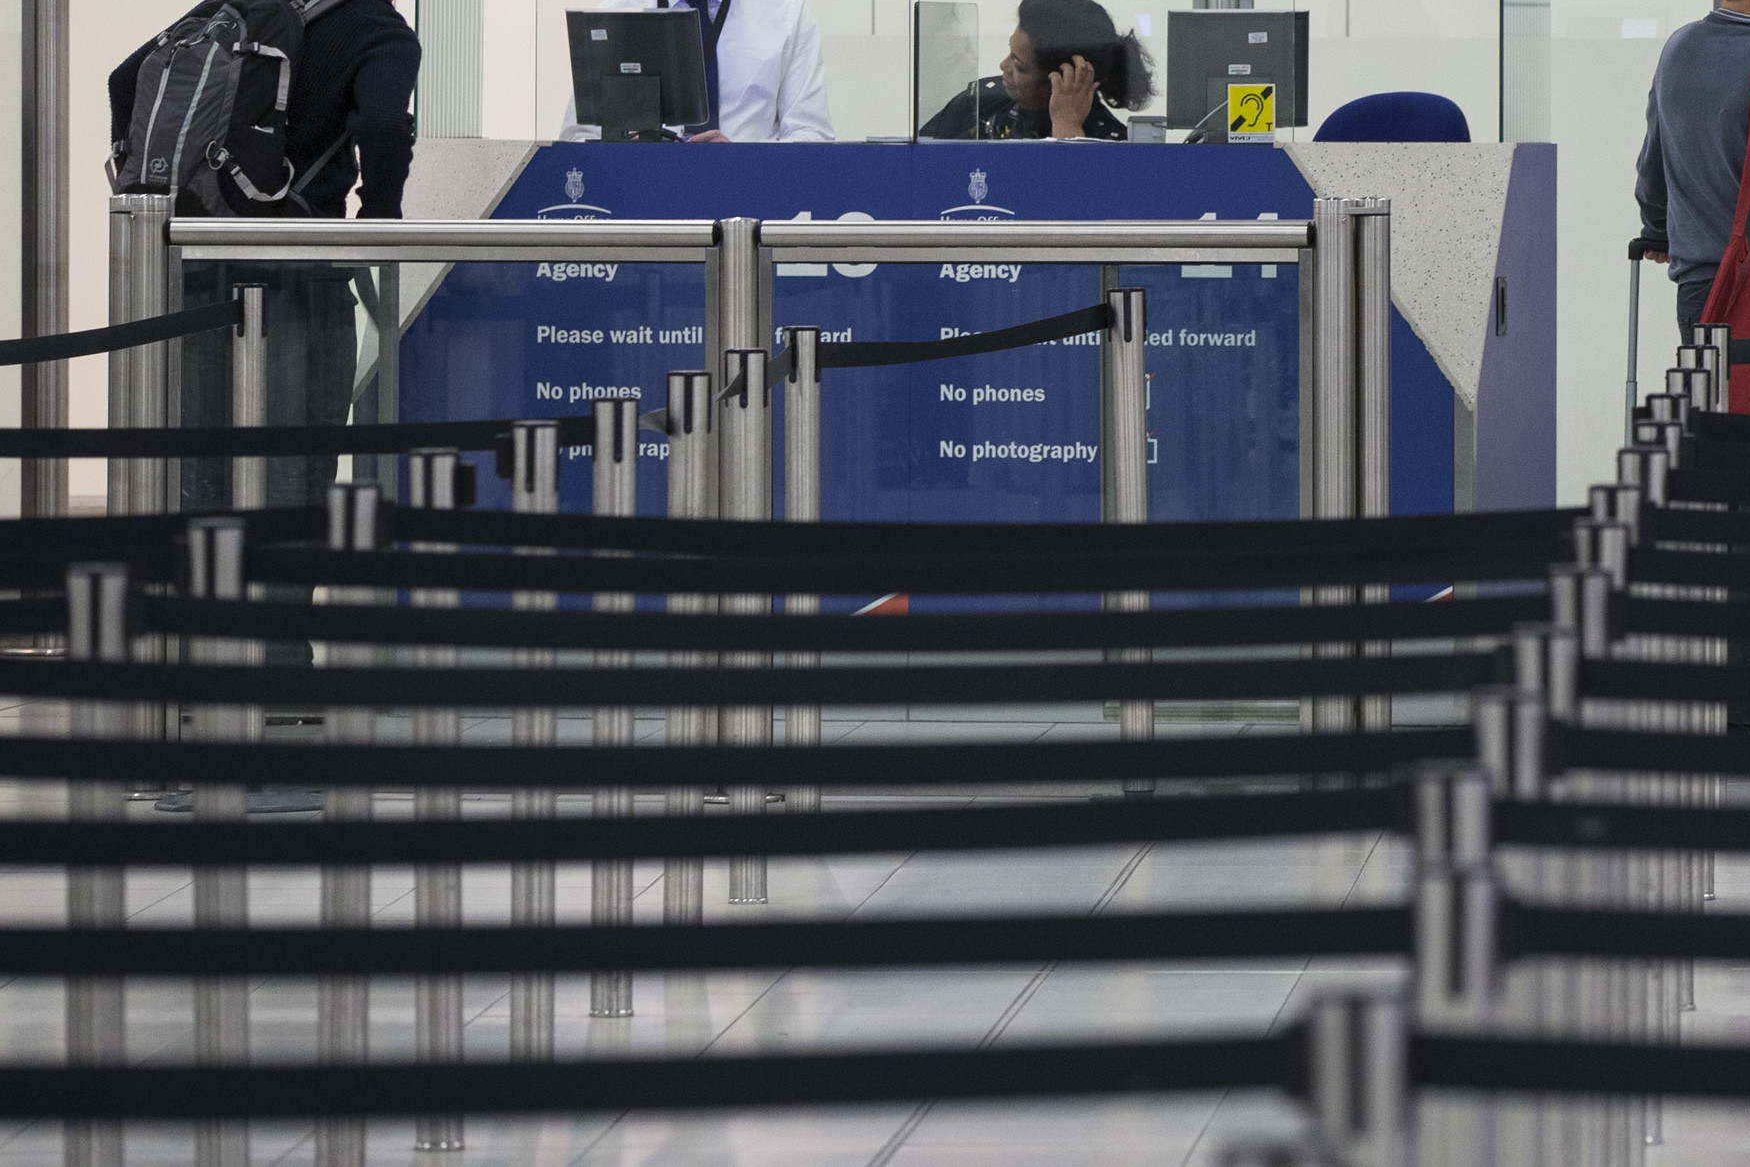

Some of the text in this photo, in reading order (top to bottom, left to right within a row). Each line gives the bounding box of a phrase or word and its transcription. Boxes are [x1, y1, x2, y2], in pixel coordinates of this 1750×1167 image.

[1265, 122, 1273, 132] T
[537, 263, 618, 281] Agency
[940, 264, 1022, 282] Agency
[538, 326, 603, 343] Please
[610, 326, 652, 343] wait
[659, 327, 702, 343] until
[1064, 330, 1100, 346] unti
[1179, 329, 1256, 346] forward
[537, 382, 642, 404] No phones
[941, 385, 1045, 405] No phones
[940, 441, 1097, 462] No photography
